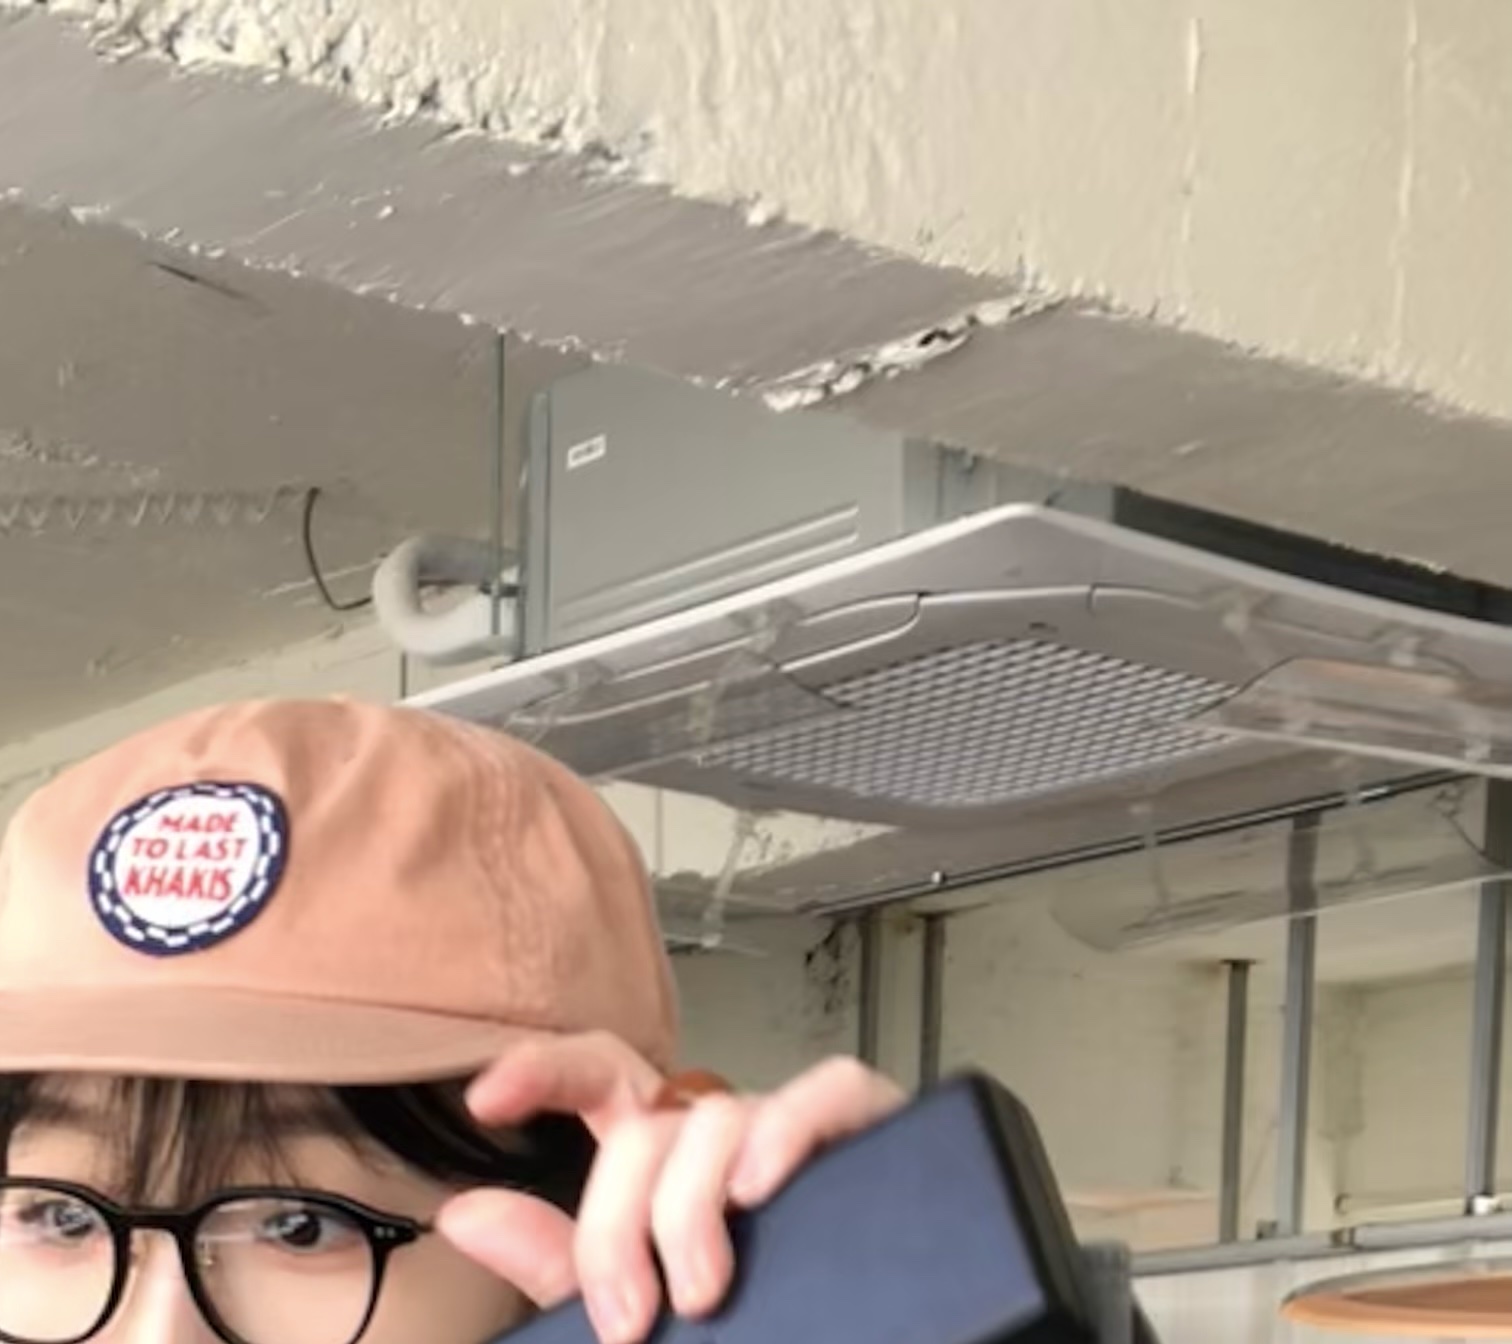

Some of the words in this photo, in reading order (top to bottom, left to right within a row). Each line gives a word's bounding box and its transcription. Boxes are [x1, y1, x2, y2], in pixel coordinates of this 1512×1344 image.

[160, 813, 238, 832] MADE
[133, 838, 168, 859] TO
[175, 838, 246, 860] LAST
[123, 866, 234, 901] KHAKIS
